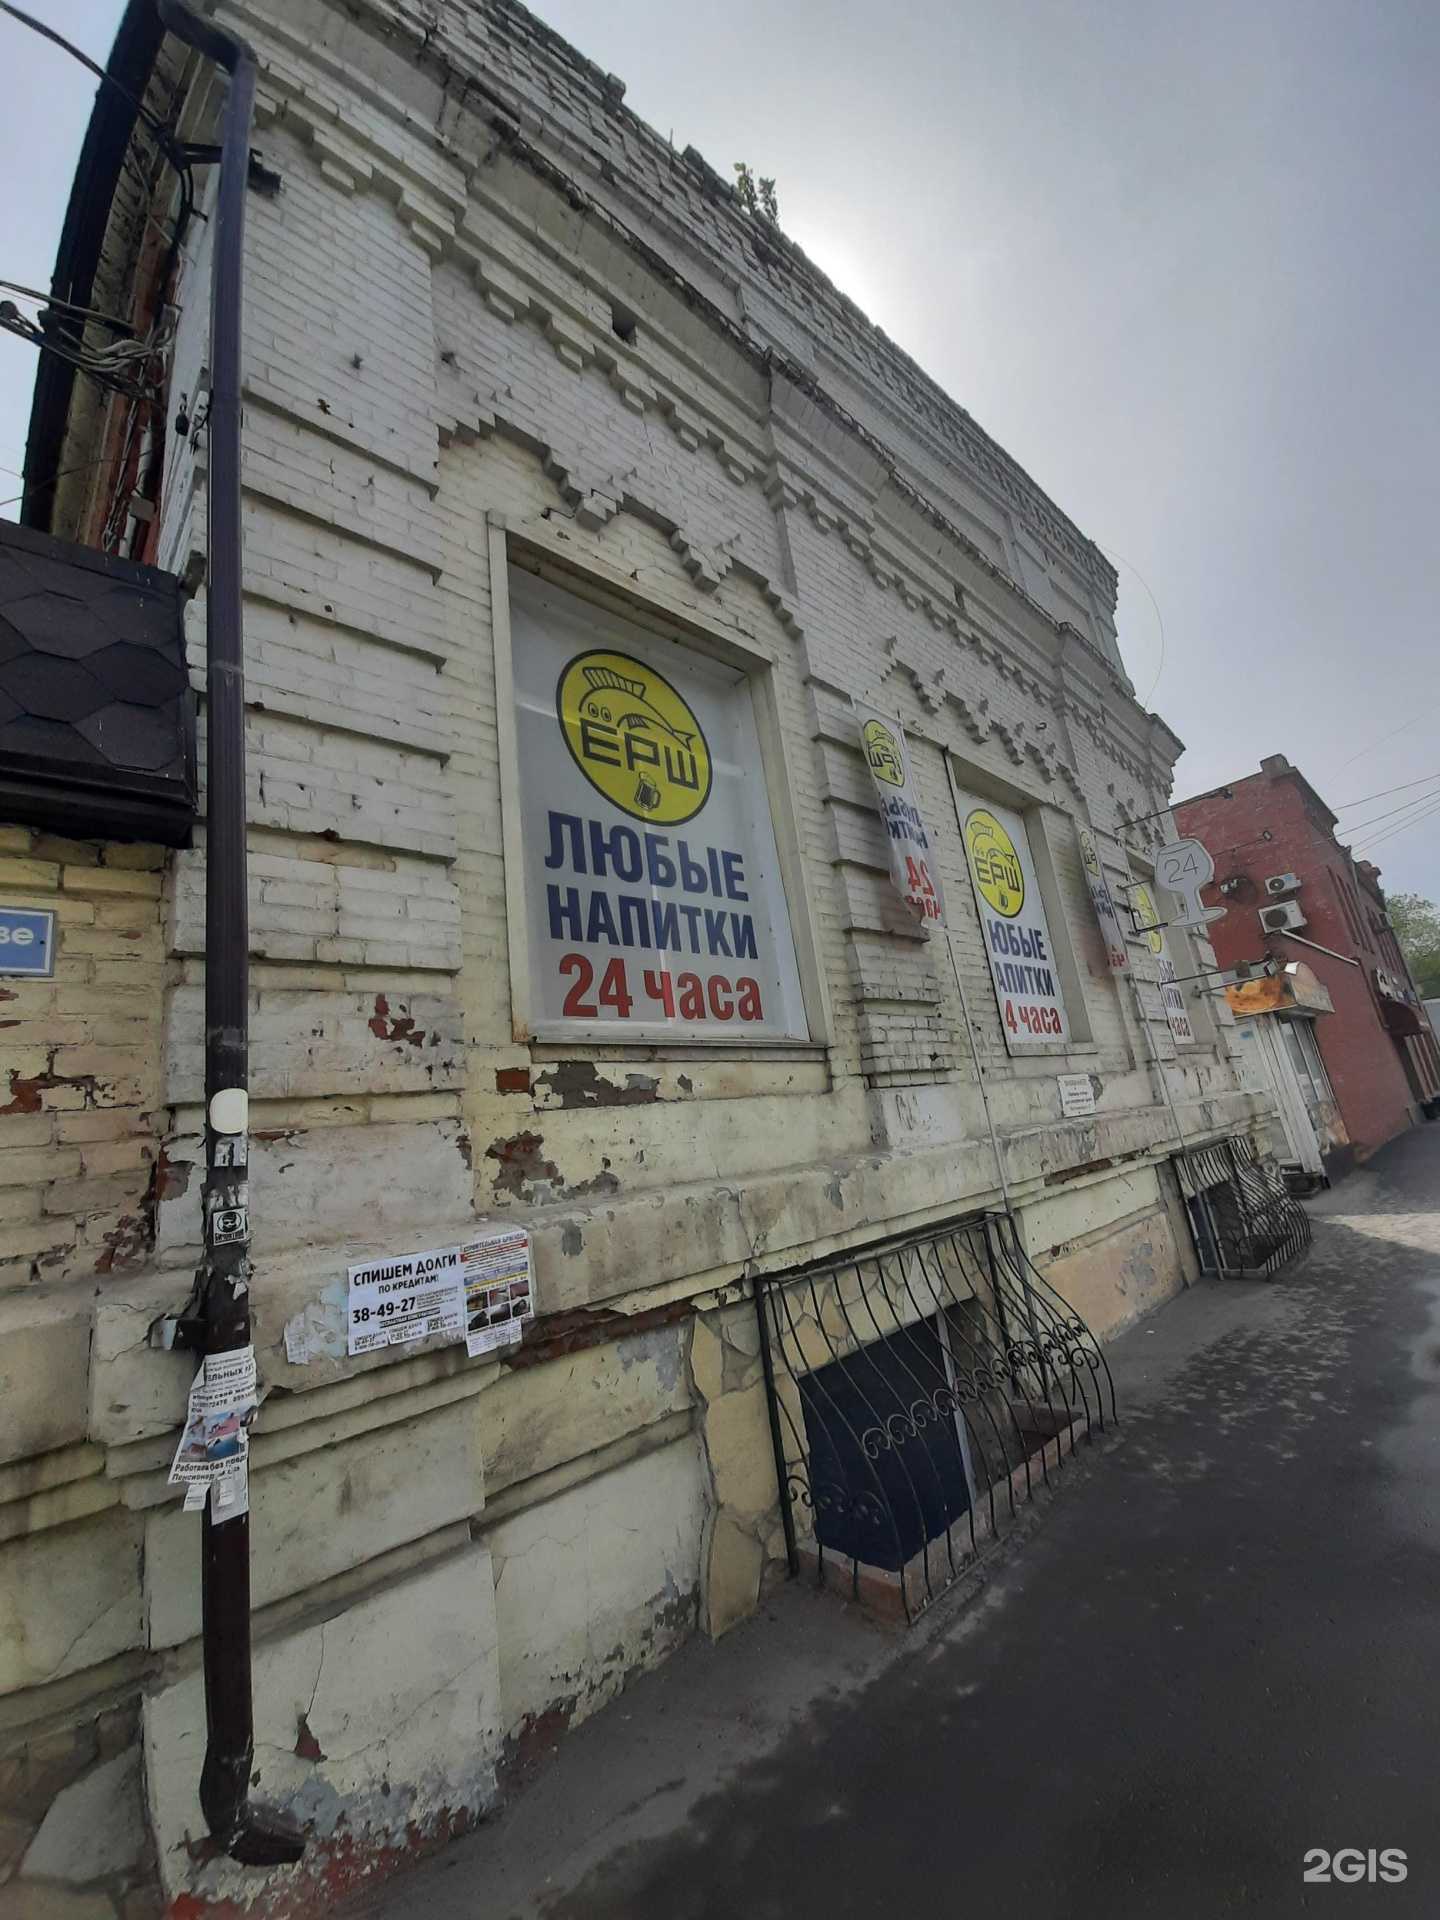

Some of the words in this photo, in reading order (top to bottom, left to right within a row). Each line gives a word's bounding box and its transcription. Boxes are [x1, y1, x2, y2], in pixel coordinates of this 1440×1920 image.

[580, 716, 699, 791] ЕРШ
[544, 810, 749, 902] ЛЮБЫЕ
[1164, 853, 1199, 883] 24
[975, 855, 1020, 892] ЕРШ
[546, 883, 759, 960] НАПИТКИ
[559, 953, 633, 1018] 24
[643, 969, 763, 1021] часа
[1018, 1006, 1063, 1034] часа
[354, 1263, 412, 1286] СПИШЕМ
[416, 1254, 457, 1275] ДОЛГИ
[378, 1284, 391, 1294] ПО
[353, 1296, 416, 1324] 38-49-27
